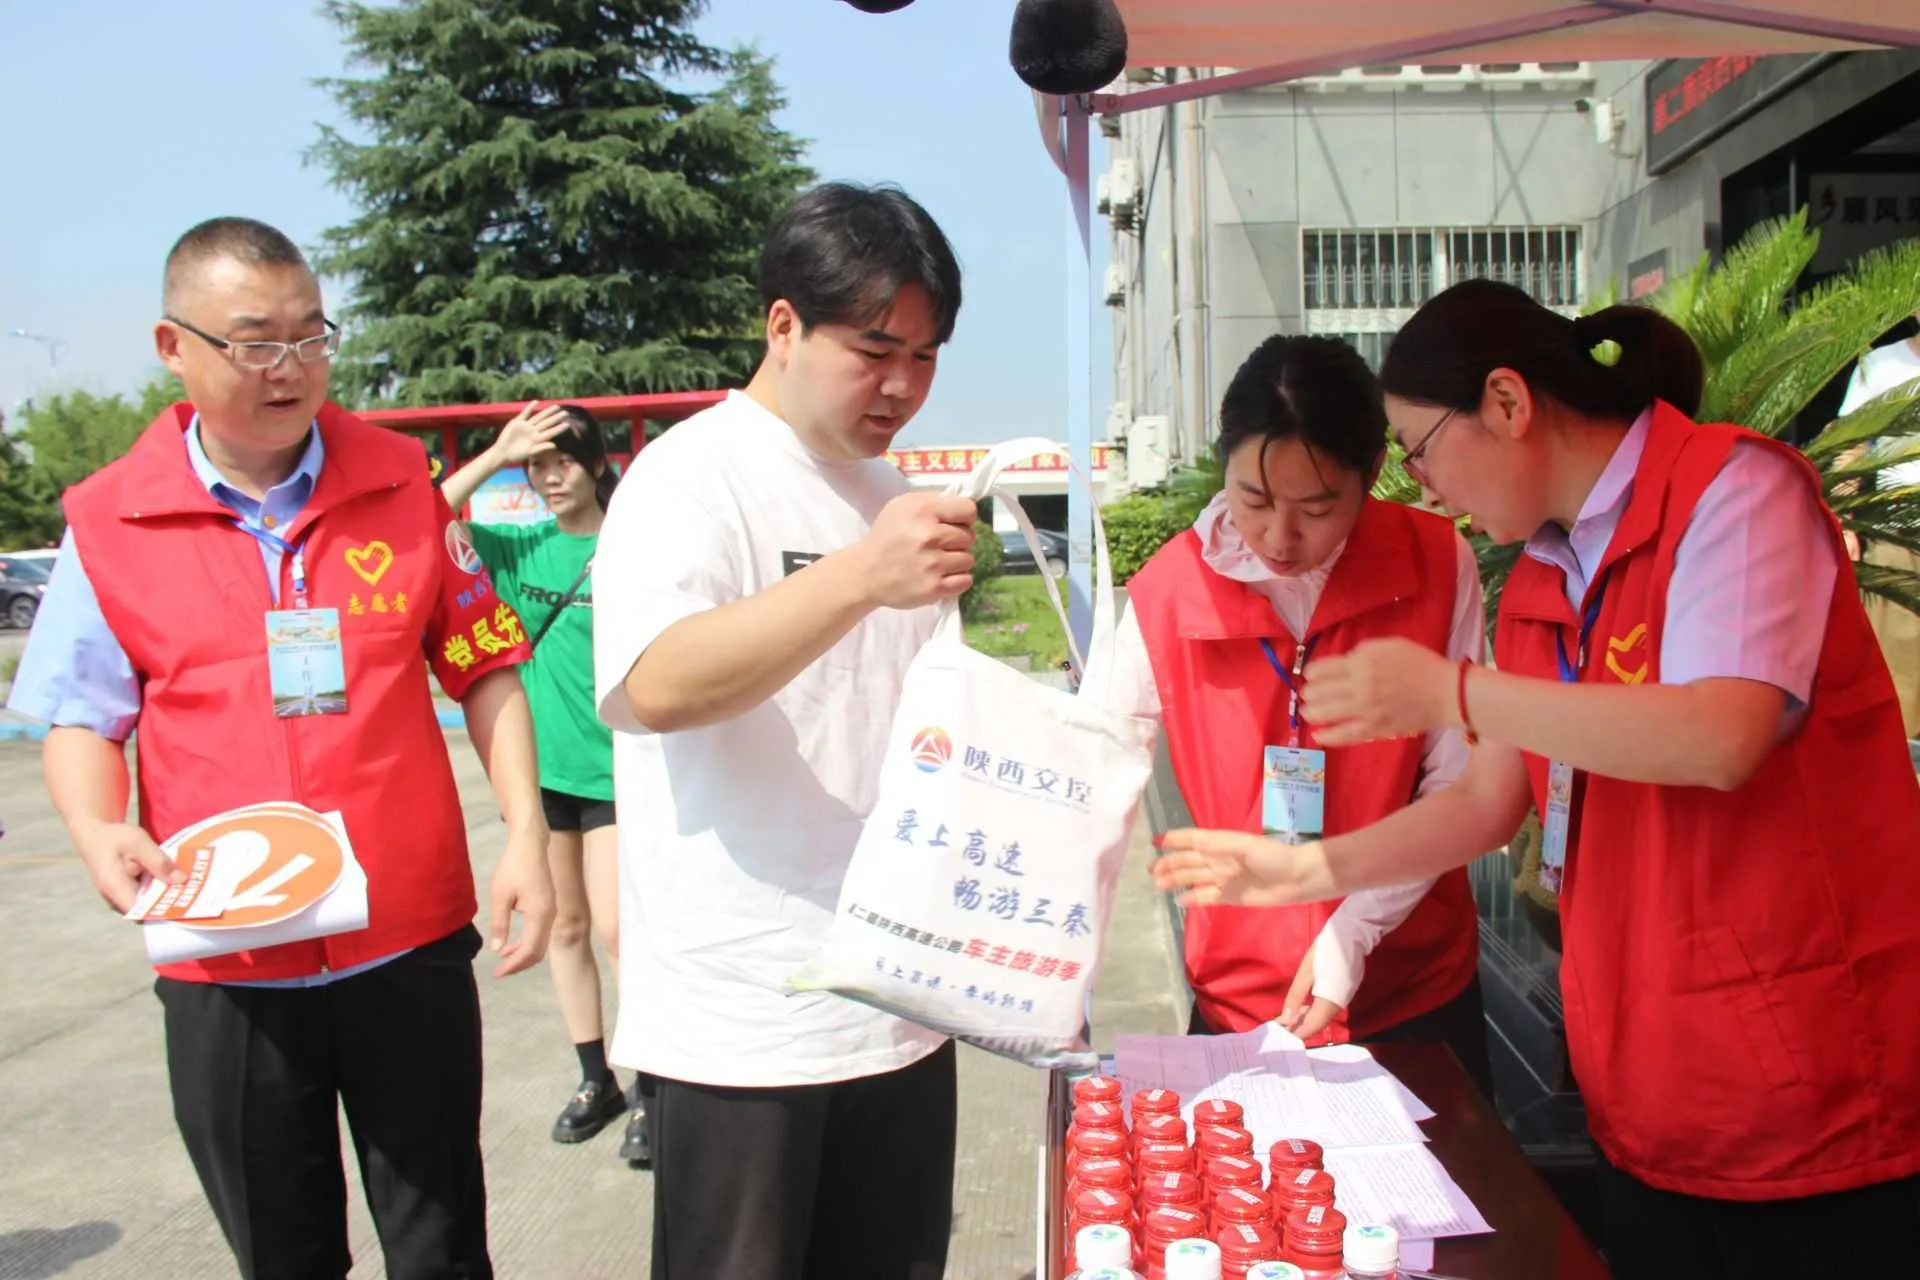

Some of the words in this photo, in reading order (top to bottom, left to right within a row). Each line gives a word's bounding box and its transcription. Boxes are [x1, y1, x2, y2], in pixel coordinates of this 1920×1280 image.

[963, 745, 1092, 804] 陕西交控
[894, 808, 1025, 877] 爱上高速
[953, 876, 1092, 938] 畅游三秦
